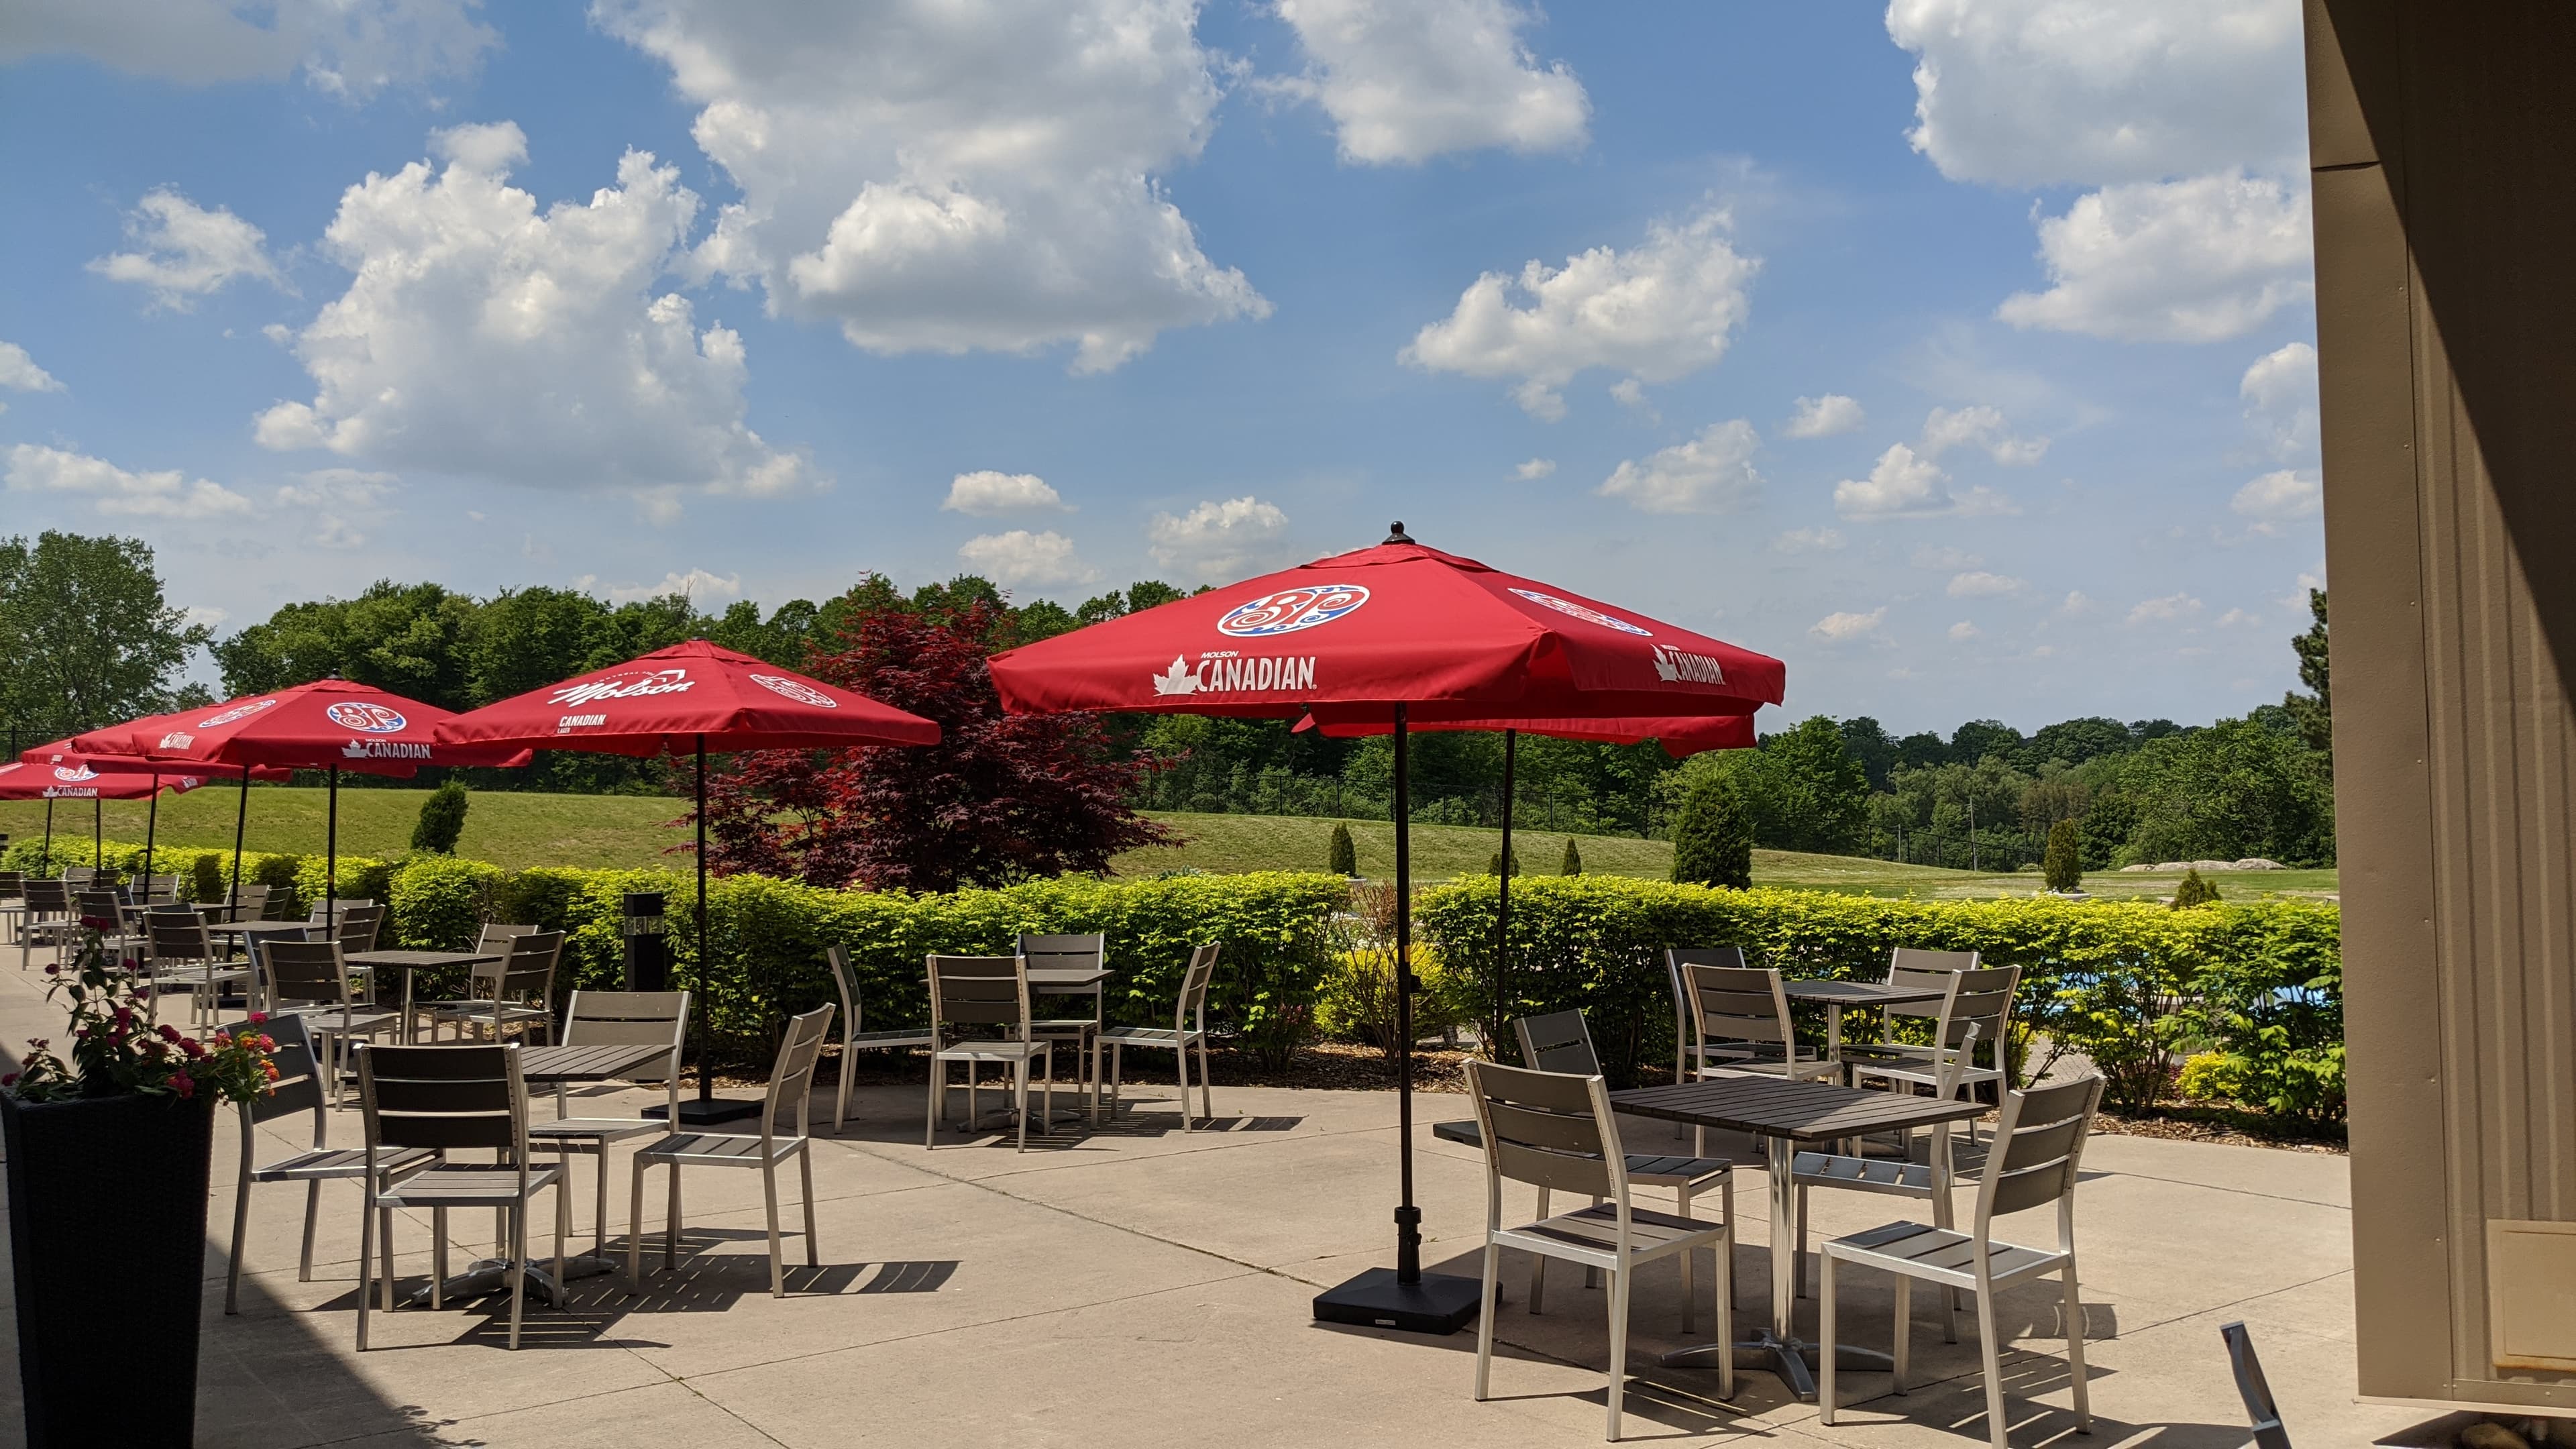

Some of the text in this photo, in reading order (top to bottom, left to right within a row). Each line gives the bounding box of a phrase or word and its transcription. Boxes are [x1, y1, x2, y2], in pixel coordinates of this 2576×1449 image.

[1201, 651, 1239, 659] MOLSON
[1197, 657, 1316, 692] CANADIAN
[1668, 651, 1724, 685] CANADIAN
[547, 680, 696, 708] Molson
[559, 714, 607, 727] CANADIAN
[366, 743, 431, 759] CANADIAN
[57, 788, 98, 797] CANADIAN
